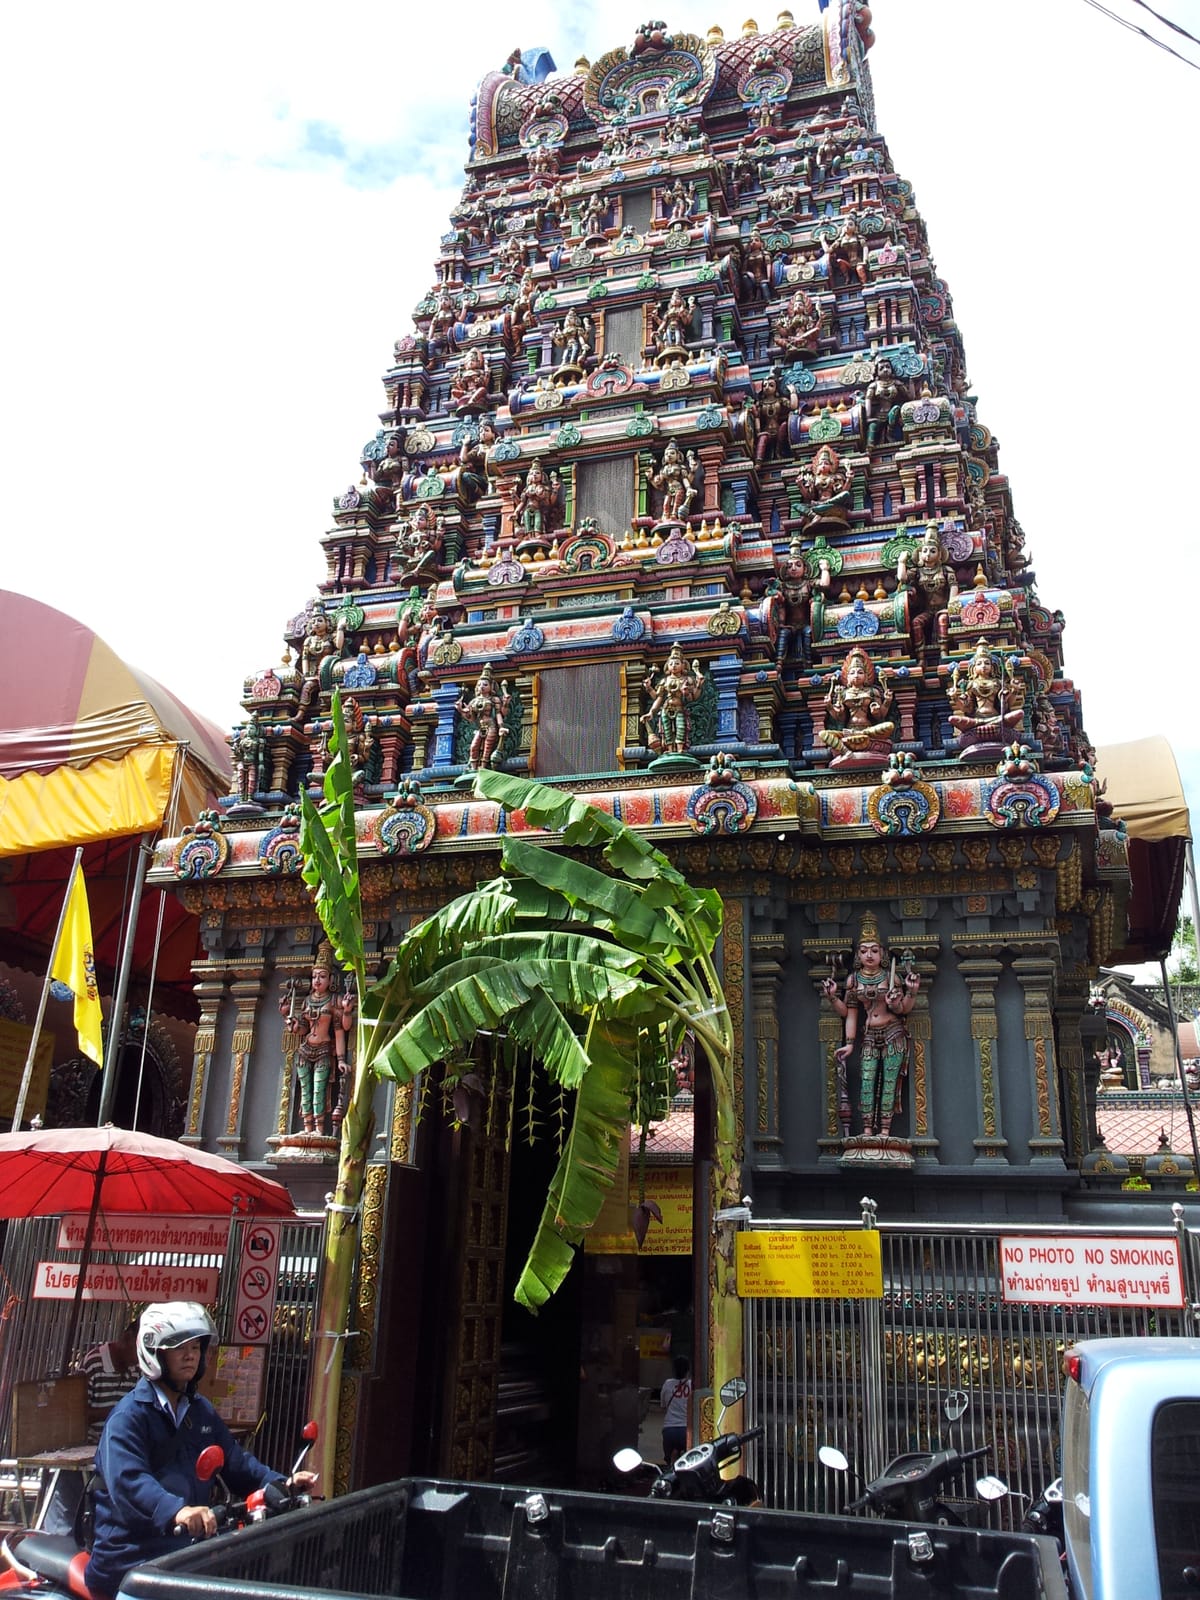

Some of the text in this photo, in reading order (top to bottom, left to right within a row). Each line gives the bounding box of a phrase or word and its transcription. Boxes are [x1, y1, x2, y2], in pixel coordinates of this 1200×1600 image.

[1005, 1247, 1174, 1266] NO PHOTO NO SMOKING
[1006, 1271, 1171, 1300] ห้ามถ่ายรูป ห้ามสูบบุหรี่
